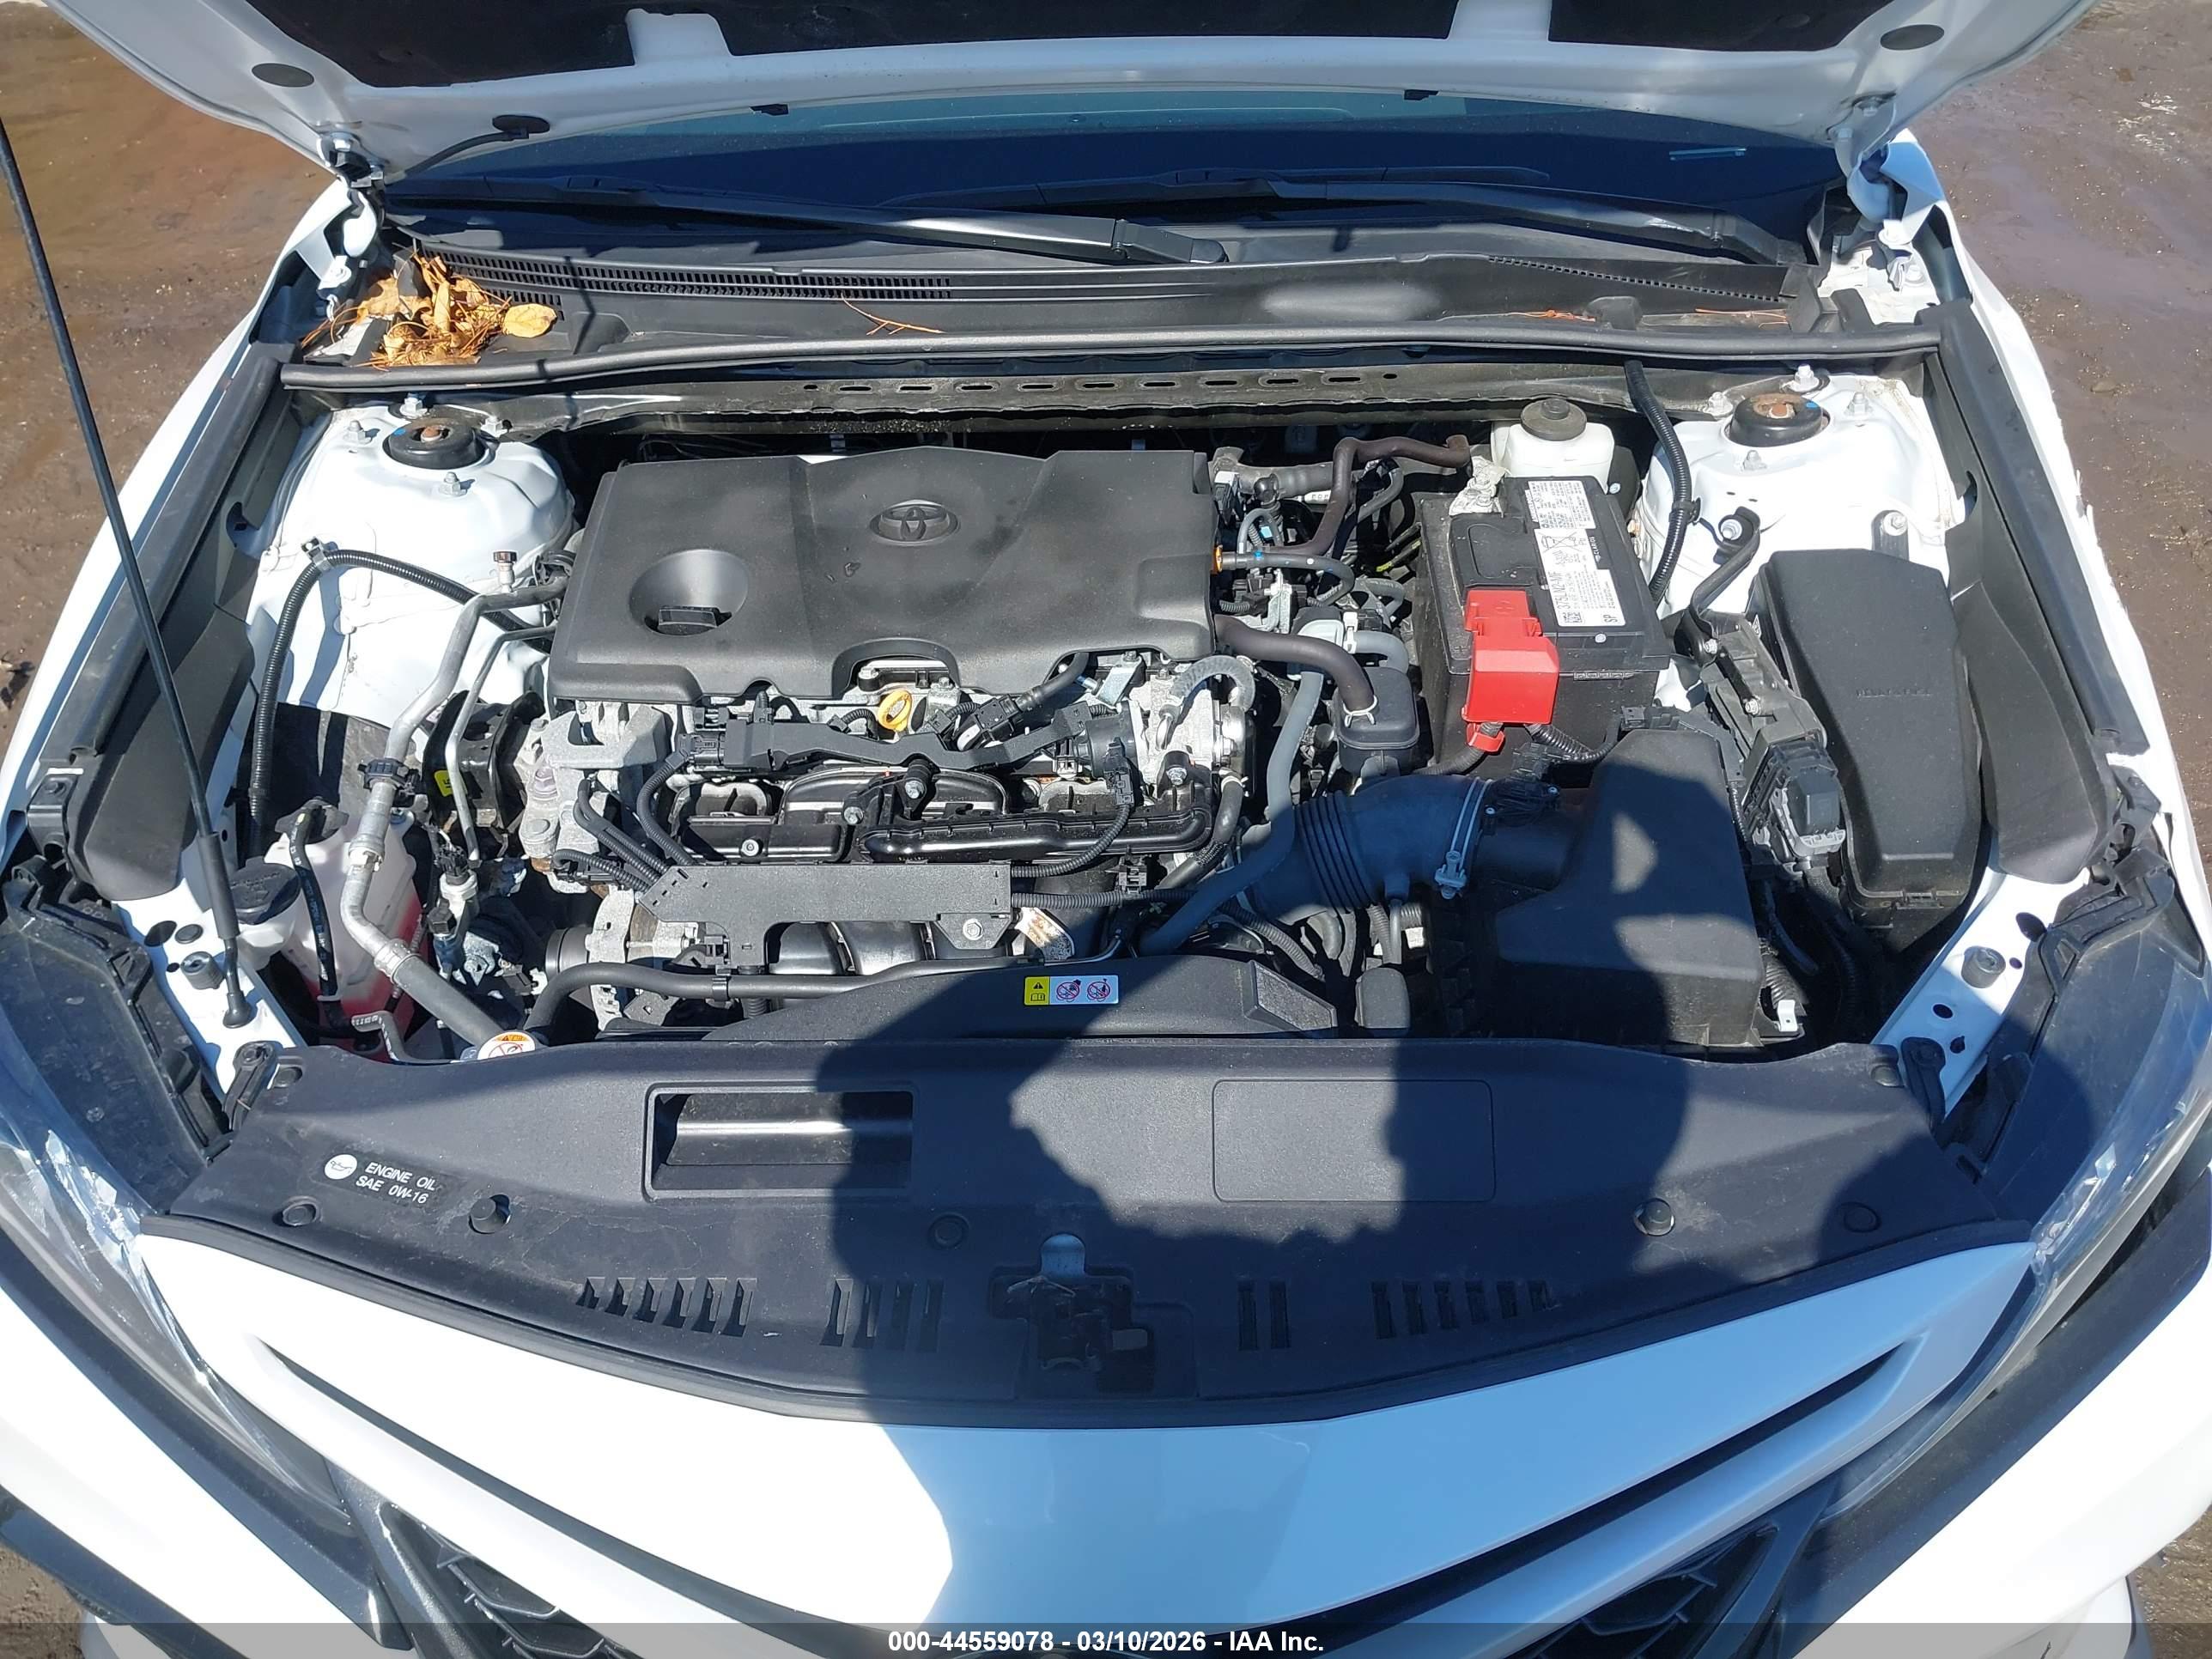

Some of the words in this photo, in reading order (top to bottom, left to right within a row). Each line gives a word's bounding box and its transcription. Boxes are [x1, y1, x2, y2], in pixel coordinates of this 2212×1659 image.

[1589, 536, 1601, 556] CLARIOS
[1602, 614, 1619, 623] SP
[365, 1162, 413, 1183] ENGINE
[416, 1176, 436, 1191] OIL
[356, 1176, 385, 1191] SAE
[388, 1185, 428, 1204] 0W-16
